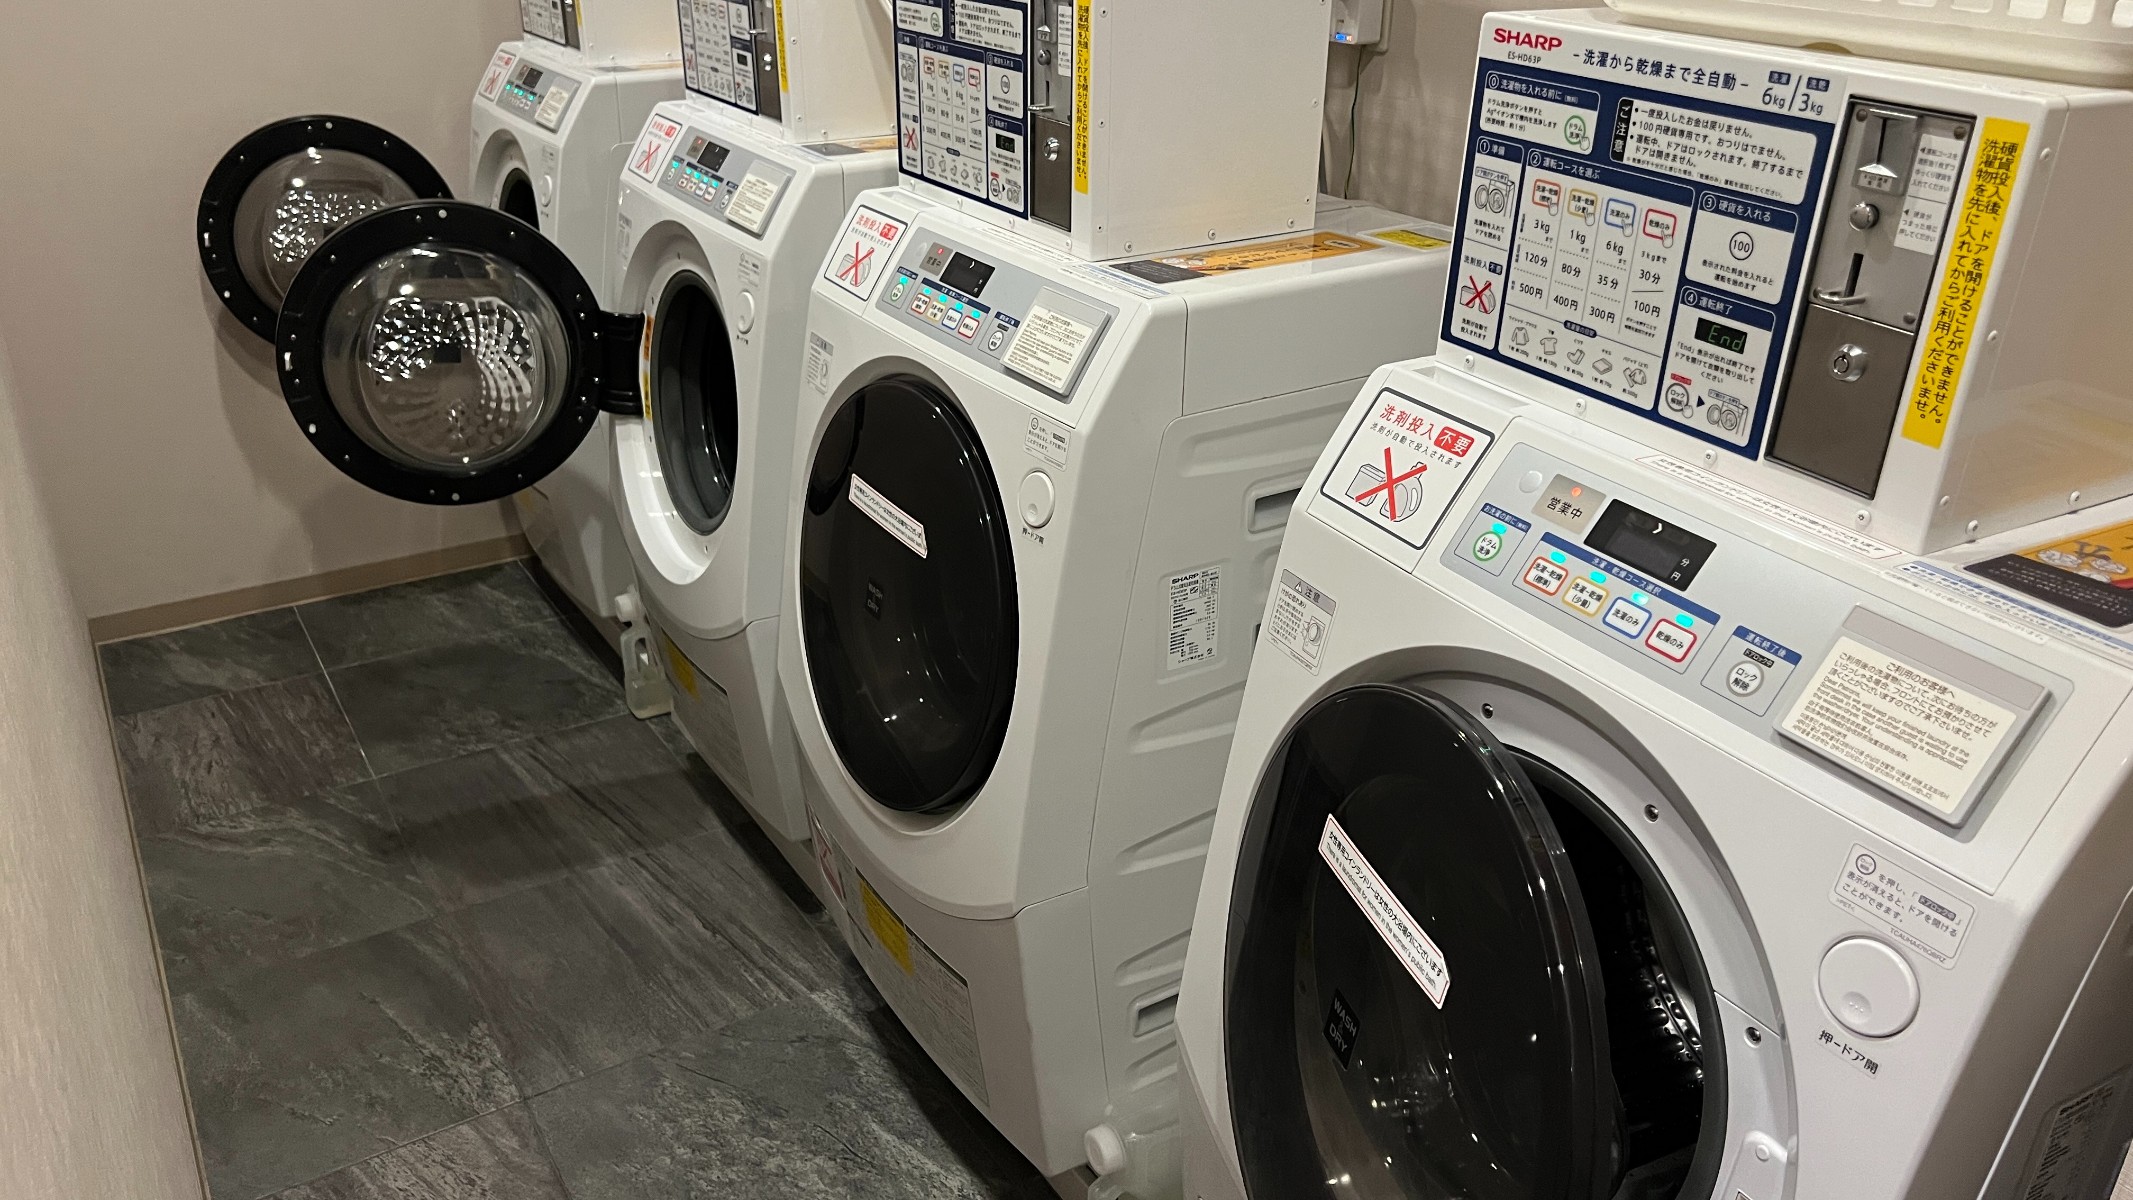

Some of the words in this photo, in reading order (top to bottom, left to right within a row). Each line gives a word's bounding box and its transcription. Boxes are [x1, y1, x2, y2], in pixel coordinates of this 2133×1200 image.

[1493, 28, 1562, 51] SHARP
[1508, 51, 1542, 64] ES-HD63P
[1500, 78, 1562, 100] 洗濯物を入れる前に
[1542, 156, 1601, 180] 運転コースを選ぶ
[1717, 199, 1772, 222] 硬貨を入れる
[1732, 239, 1750, 253] 100
[1524, 251, 1548, 268] 120分
[1560, 262, 1581, 278] 80分
[1638, 267, 1661, 285] 30分
[1914, 137, 2000, 420] 洗濯物を先に入れてからご利用くださいませ。
[1518, 282, 1543, 300] 500円
[1929, 141, 2019, 425] 硬貨投入後、ドアを開けることができません。
[1552, 294, 1578, 311] 400円
[1633, 299, 1660, 317] 100円
[1698, 295, 1732, 315] 運転終了
[1588, 305, 1615, 324] 300円
[1707, 323, 1746, 352] End
[1370, 422, 1463, 469] 洗剤が自動で投入されます
[1547, 496, 1584, 520] 営業中
[1480, 536, 1498, 550] ドラム
[1680, 558, 1690, 567] 分
[1172, 573, 1199, 585] SHARP
[1671, 572, 1681, 581] 円
[1612, 608, 1640, 627] 洗濯のみ
[1656, 630, 1684, 650] 乾燥のみ
[1743, 631, 1789, 658] 運転終了後
[1730, 676, 1751, 692] 解除
[1734, 666, 1758, 683] ロック
[1884, 661, 1957, 700] ご利用のお客様へ
[1841, 882, 1905, 923] ことができます。
[1334, 997, 1357, 1038] WASH
[1329, 1025, 1348, 1053] DRY
